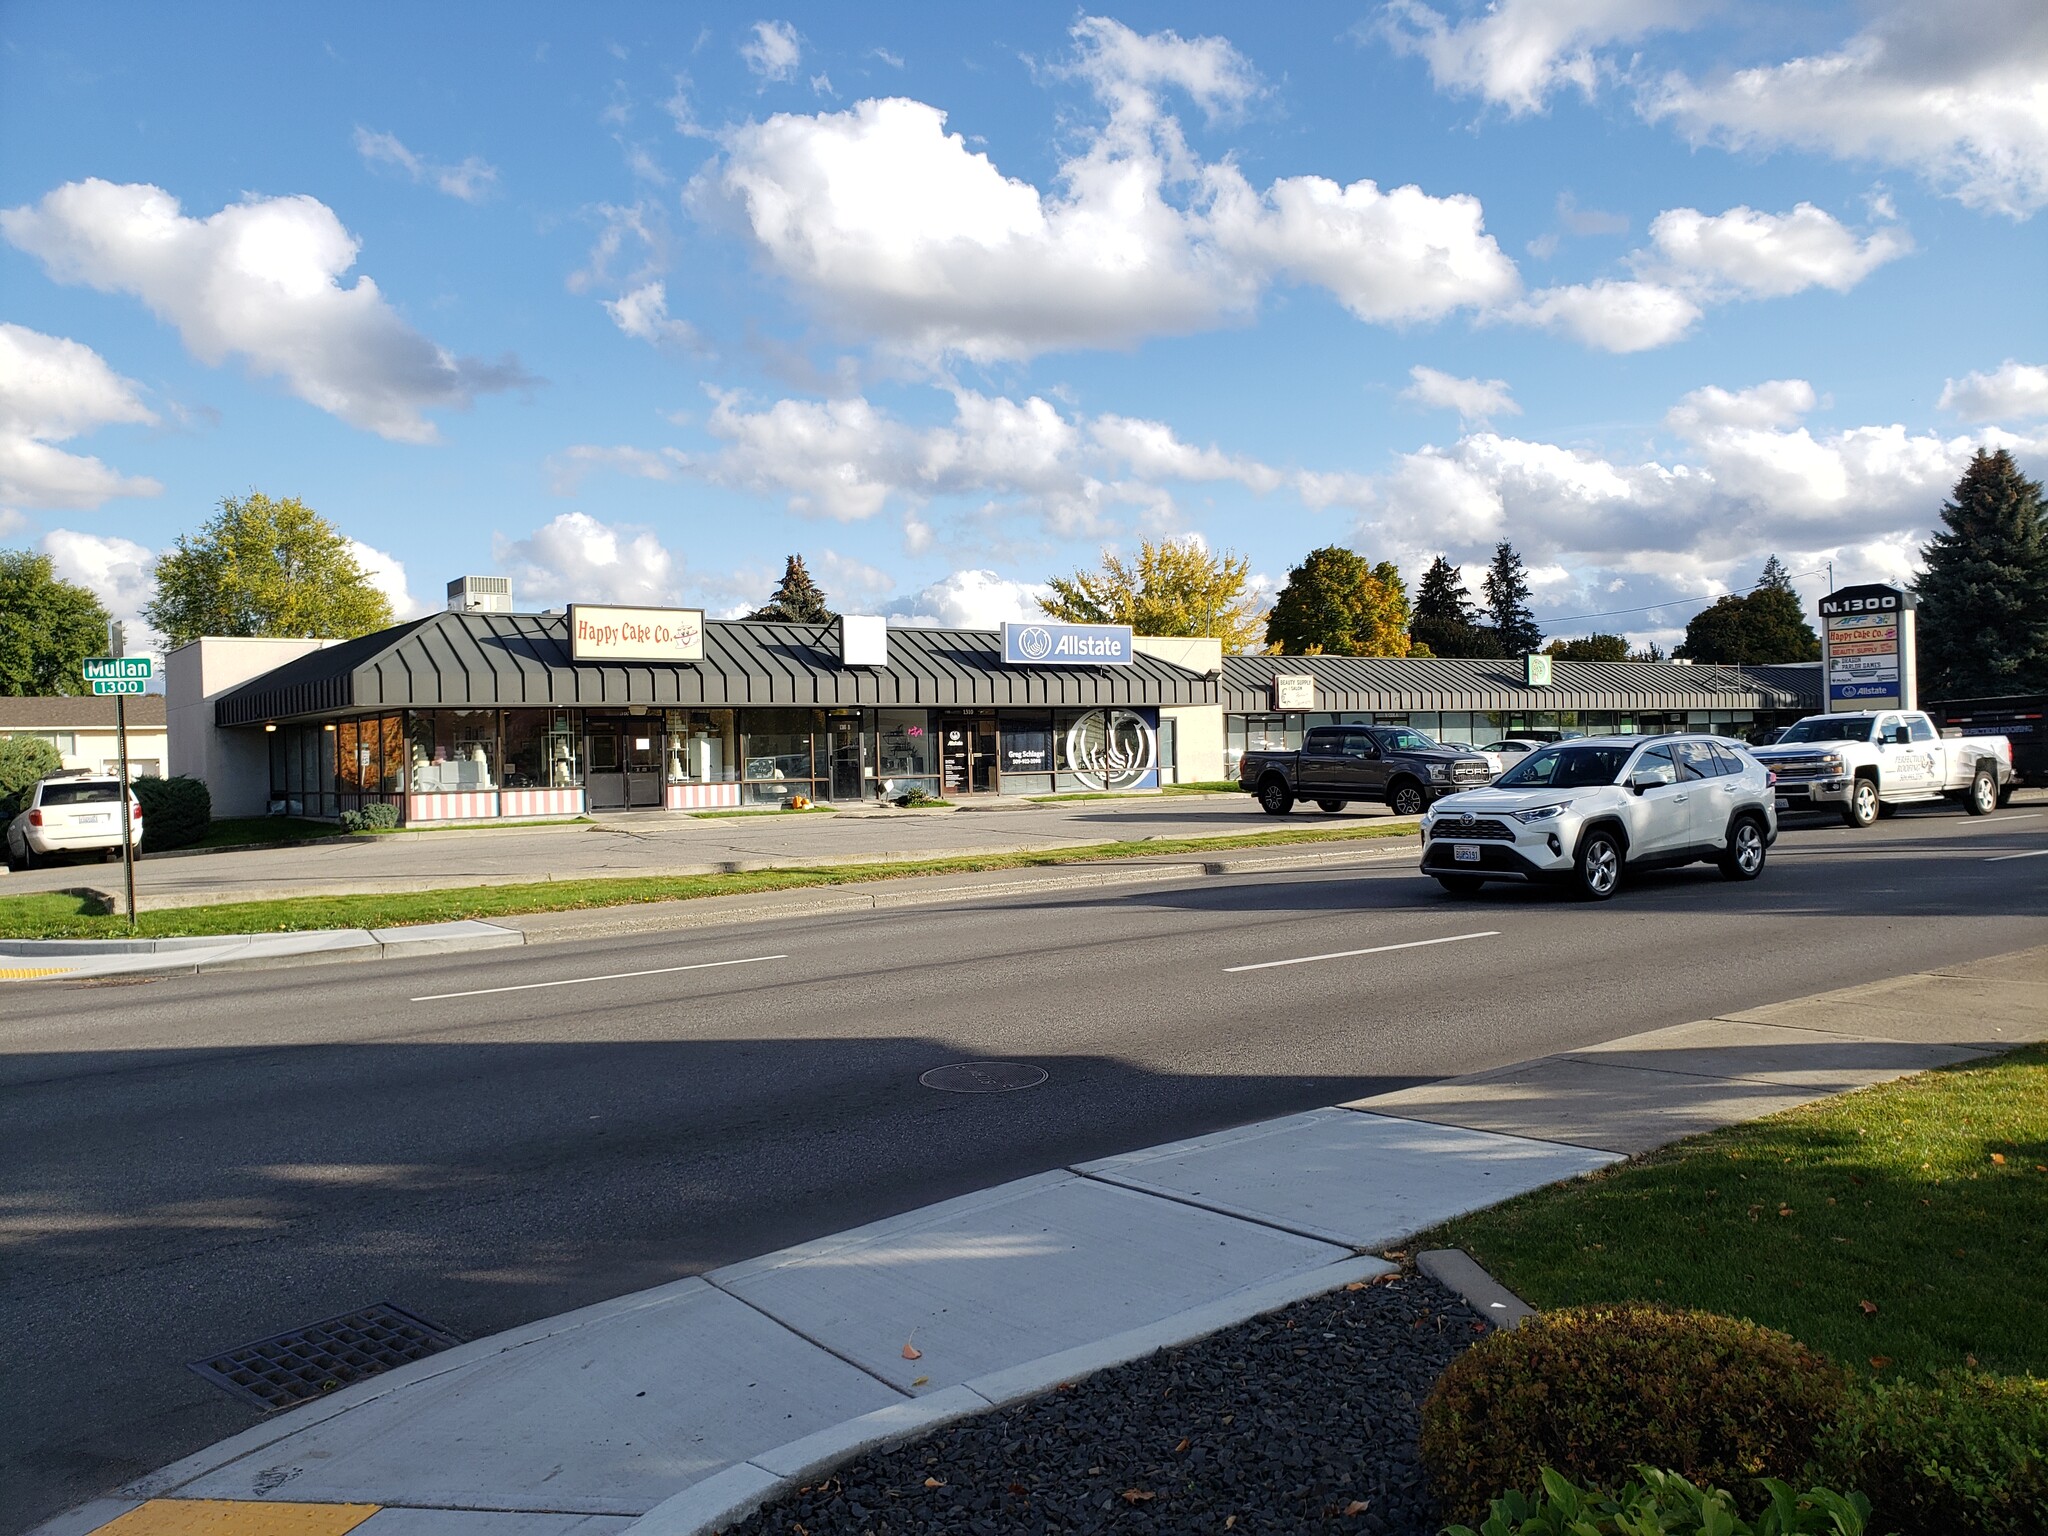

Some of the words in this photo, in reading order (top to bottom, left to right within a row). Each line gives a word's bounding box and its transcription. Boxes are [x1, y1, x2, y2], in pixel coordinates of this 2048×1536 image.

[1823, 596, 1896, 613] N.1300
[578, 620, 619, 646] Happy
[621, 622, 651, 643] Cake
[654, 625, 673, 643] Co.
[1830, 631, 1852, 641] Happy
[1853, 629, 1871, 639] Cake
[1872, 629, 1884, 638] Co.
[1054, 635, 1121, 656] Allstate
[88, 659, 148, 678] Mullan
[101, 681, 138, 693] 1300
[1857, 687, 1887, 695] Allstate
[1008, 751, 1022, 759] Greg
[1022, 750, 1045, 759] Schlagel
